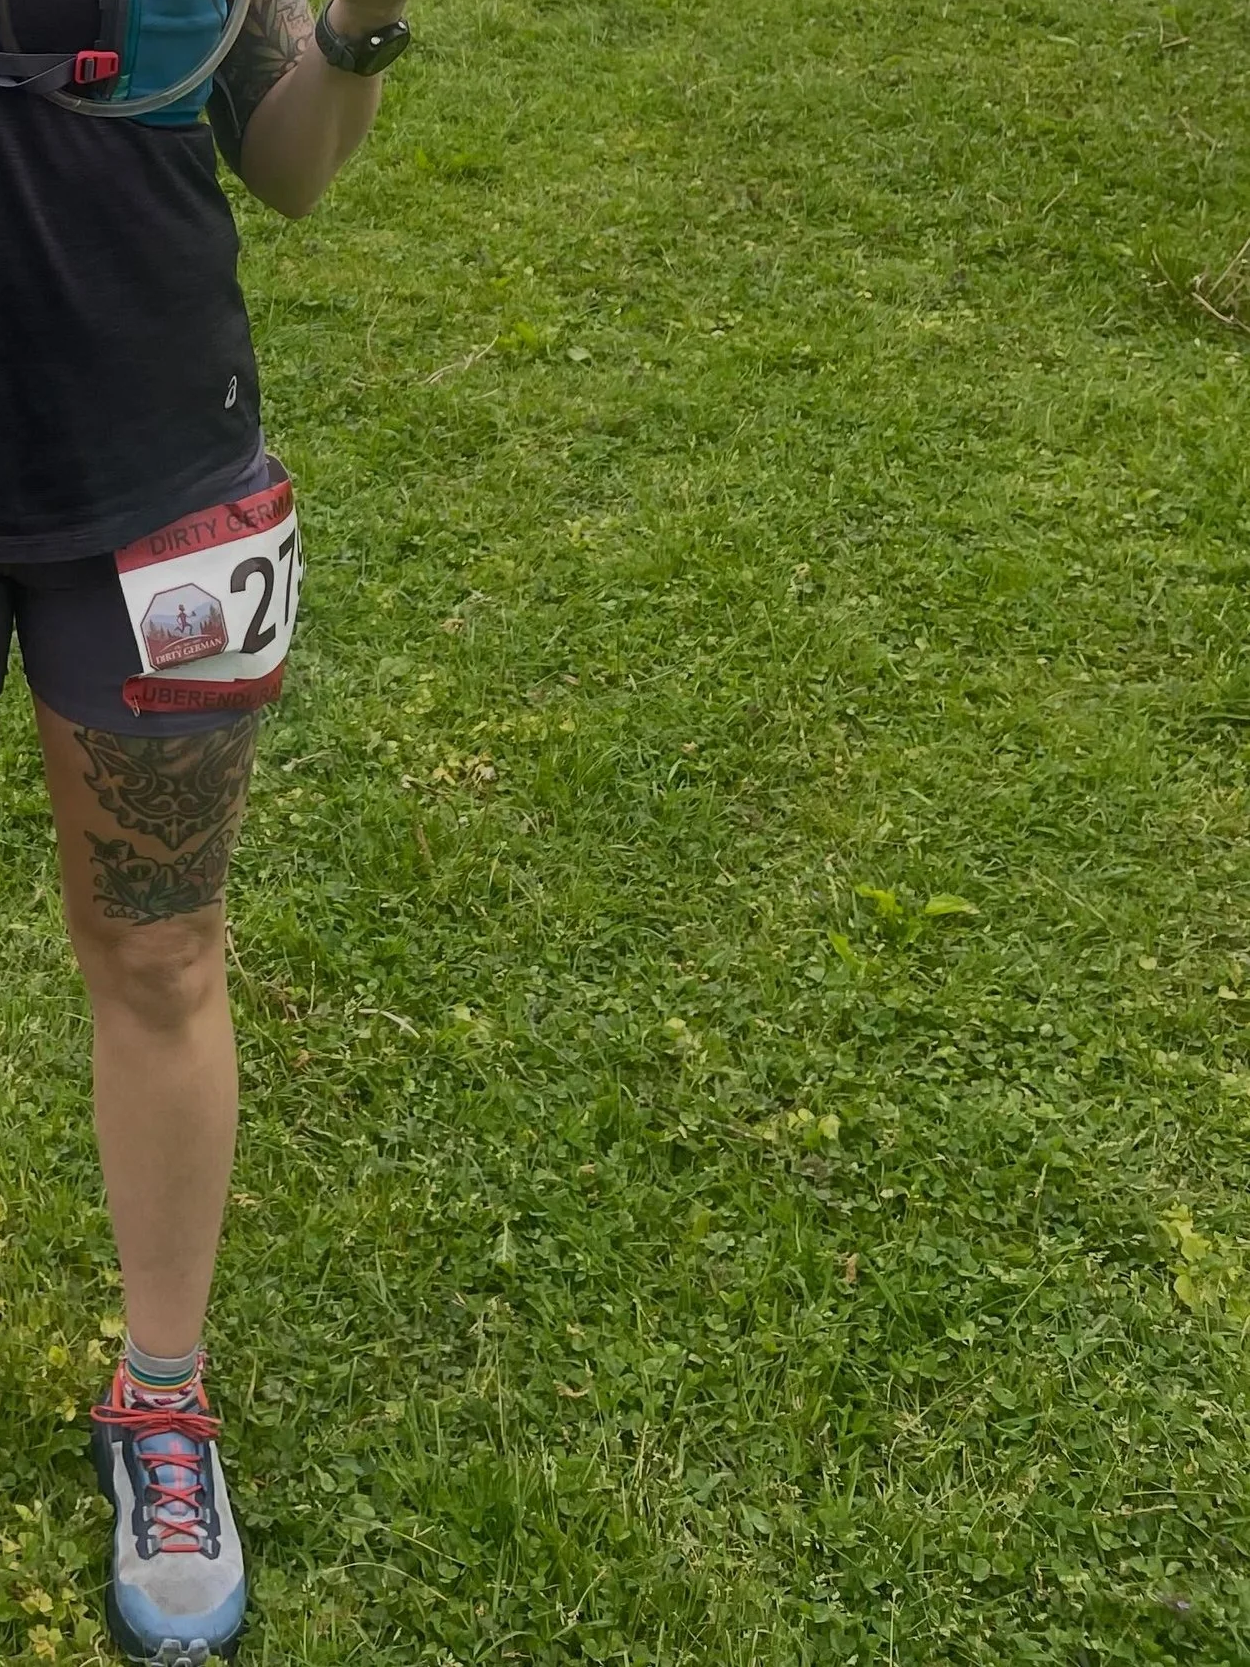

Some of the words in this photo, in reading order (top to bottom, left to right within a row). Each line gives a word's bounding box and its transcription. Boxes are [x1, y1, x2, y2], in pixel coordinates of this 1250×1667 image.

[151, 517, 218, 556] DIRTY
[226, 488, 294, 533] GERMA
[230, 527, 298, 654] 27
[155, 649, 183, 665] DIRTY
[182, 637, 223, 656] GERMAN
[142, 683, 282, 708] UBERENDURA
